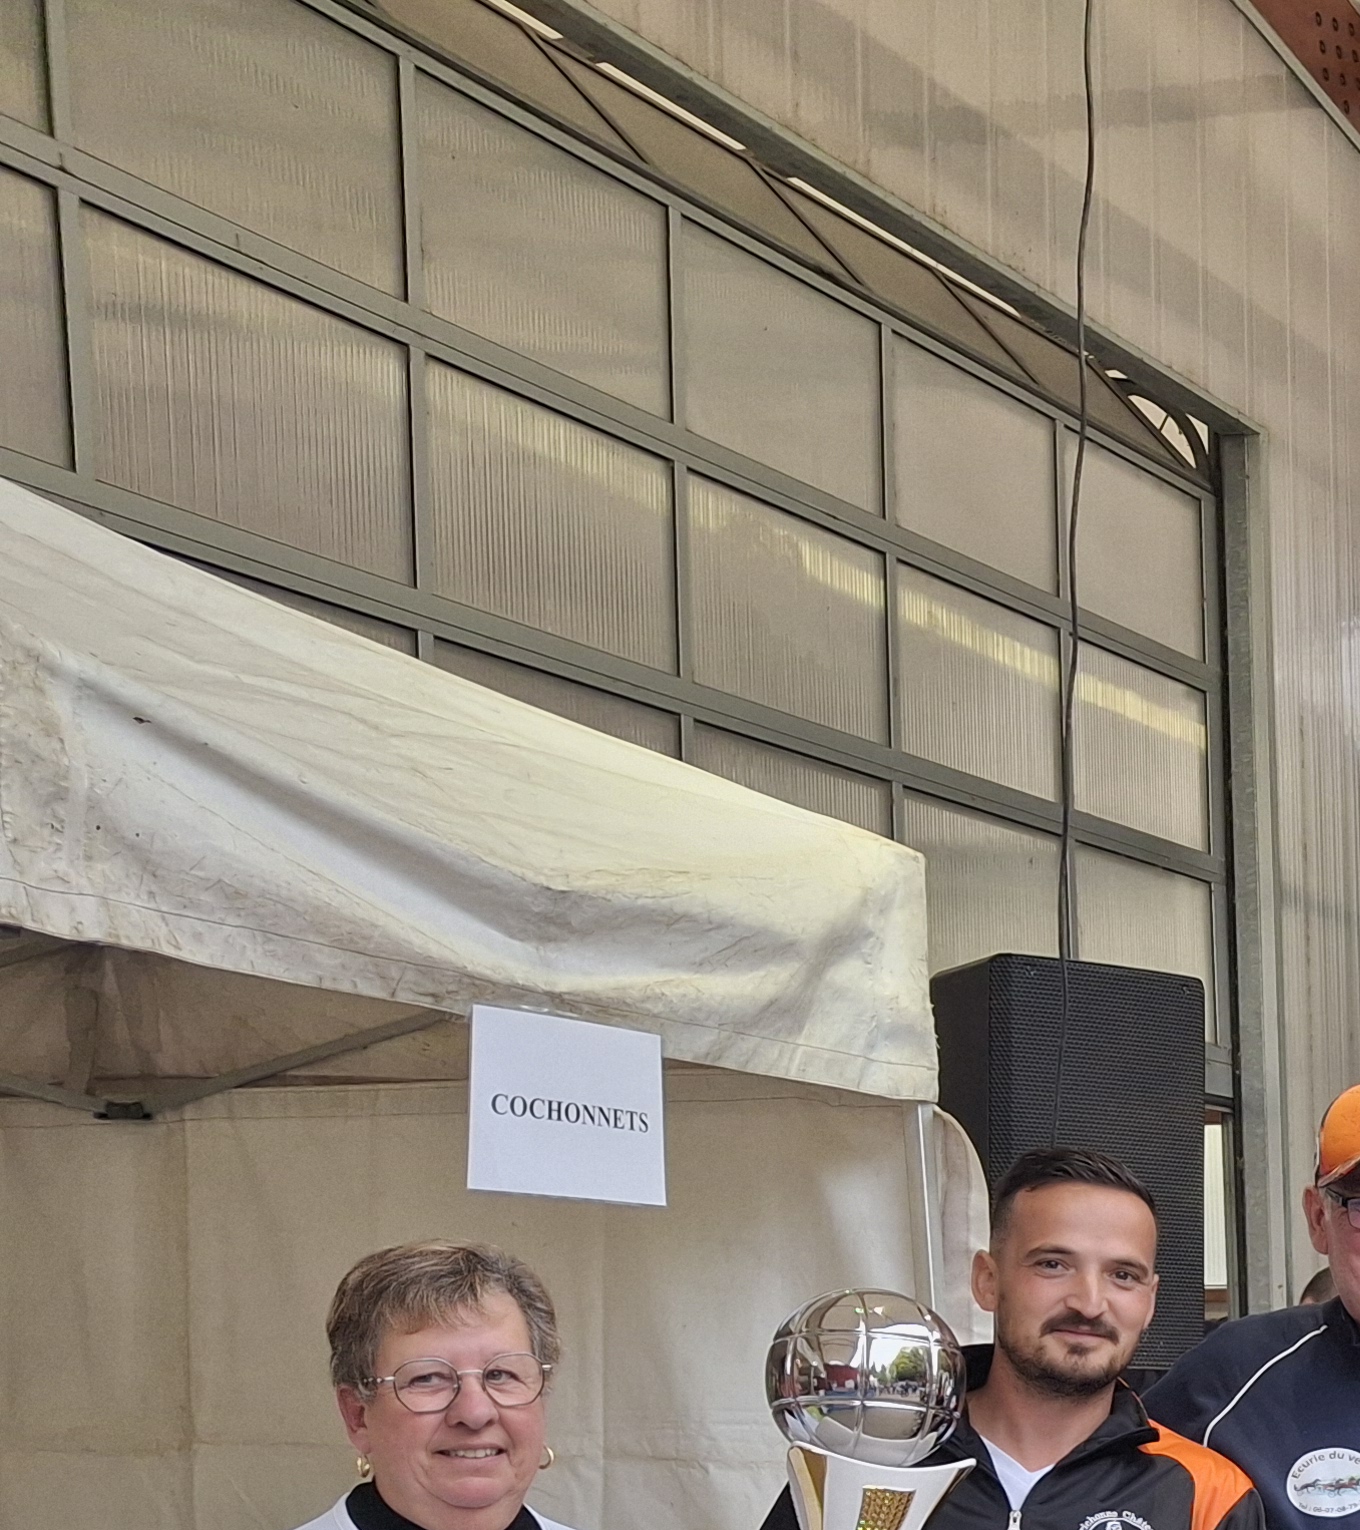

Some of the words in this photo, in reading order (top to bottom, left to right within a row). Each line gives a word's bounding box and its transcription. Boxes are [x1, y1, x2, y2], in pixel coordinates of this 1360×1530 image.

[491, 1093, 649, 1133] COCHONNETS
[1291, 1454, 1325, 1479] Ecurie
[1329, 1450, 1345, 1460] du
